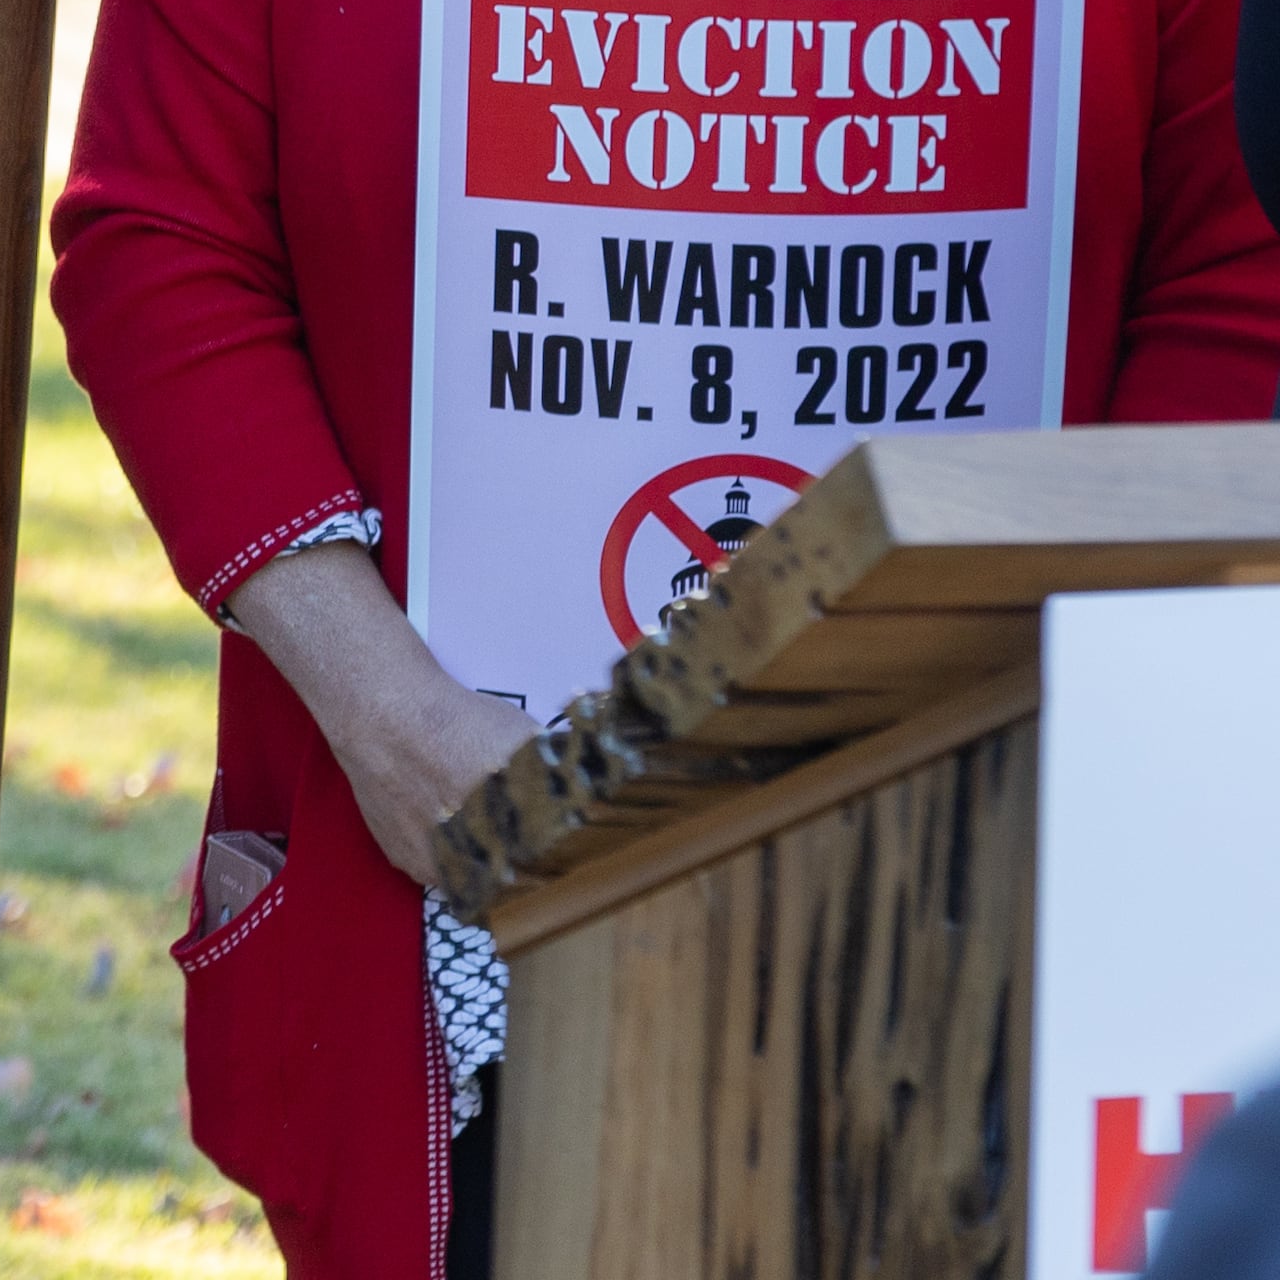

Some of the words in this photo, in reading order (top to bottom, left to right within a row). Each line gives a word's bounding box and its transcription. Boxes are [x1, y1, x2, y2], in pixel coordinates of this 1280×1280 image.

[492, 4, 1010, 99] EVICTION
[547, 104, 947, 195] NOTICE
[493, 229, 565, 318] R.
[601, 237, 993, 329] WARNOCK
[489, 329, 653, 421] NOV.
[690, 344, 758, 440] 8,
[794, 339, 989, 426] 2022
